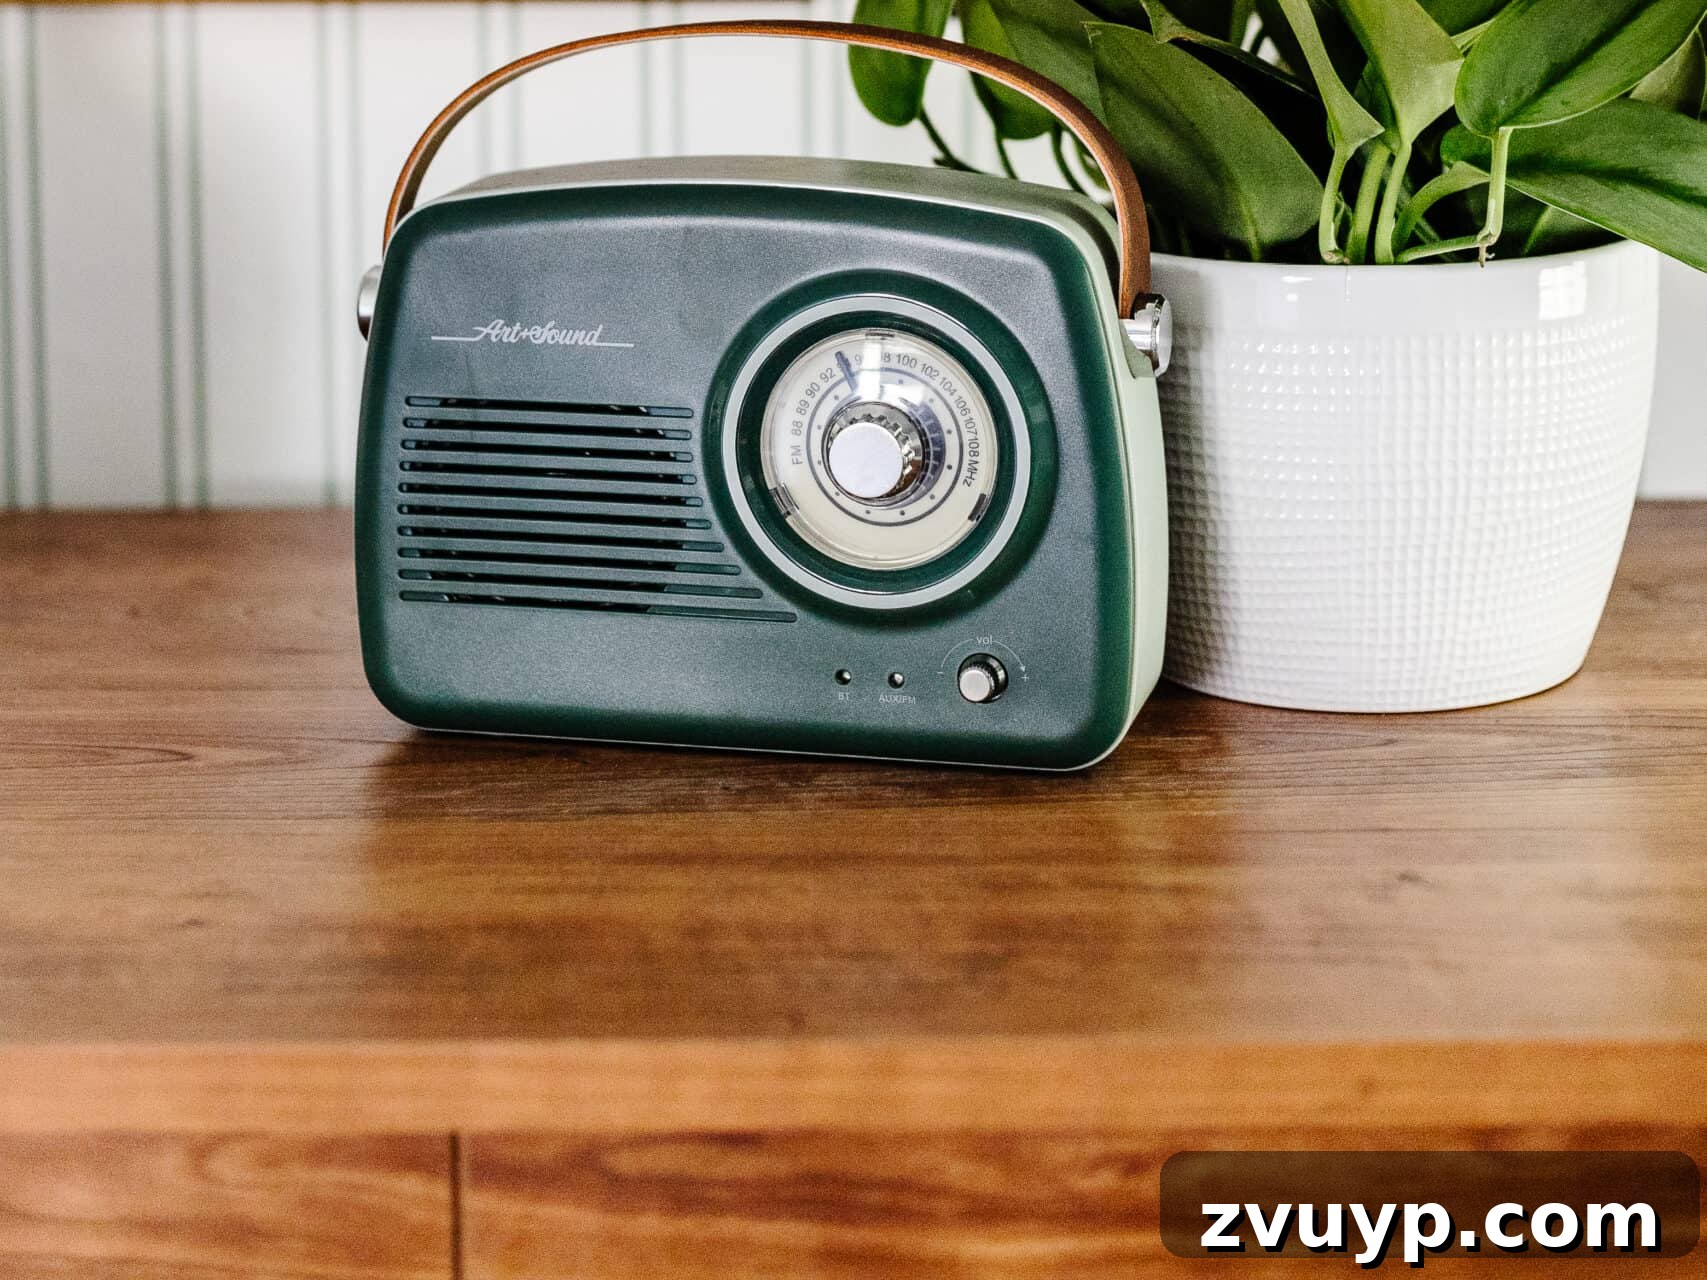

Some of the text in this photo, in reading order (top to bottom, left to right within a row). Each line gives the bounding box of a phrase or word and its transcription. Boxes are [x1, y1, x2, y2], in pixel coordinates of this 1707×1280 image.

[895, 353, 918, 369] 100
[819, 367, 836, 383] 92
[920, 363, 940, 380] 102
[805, 382, 820, 398] 90
[940, 377, 957, 396] 104
[796, 400, 810, 416] 89
[955, 395, 971, 417] 106
[791, 420, 803, 436] 88
[964, 417, 978, 436] 107
[790, 444, 803, 465] FM
[968, 437, 980, 457] 108
[962, 460, 979, 487] MHz
[976, 634, 993, 645] vol
